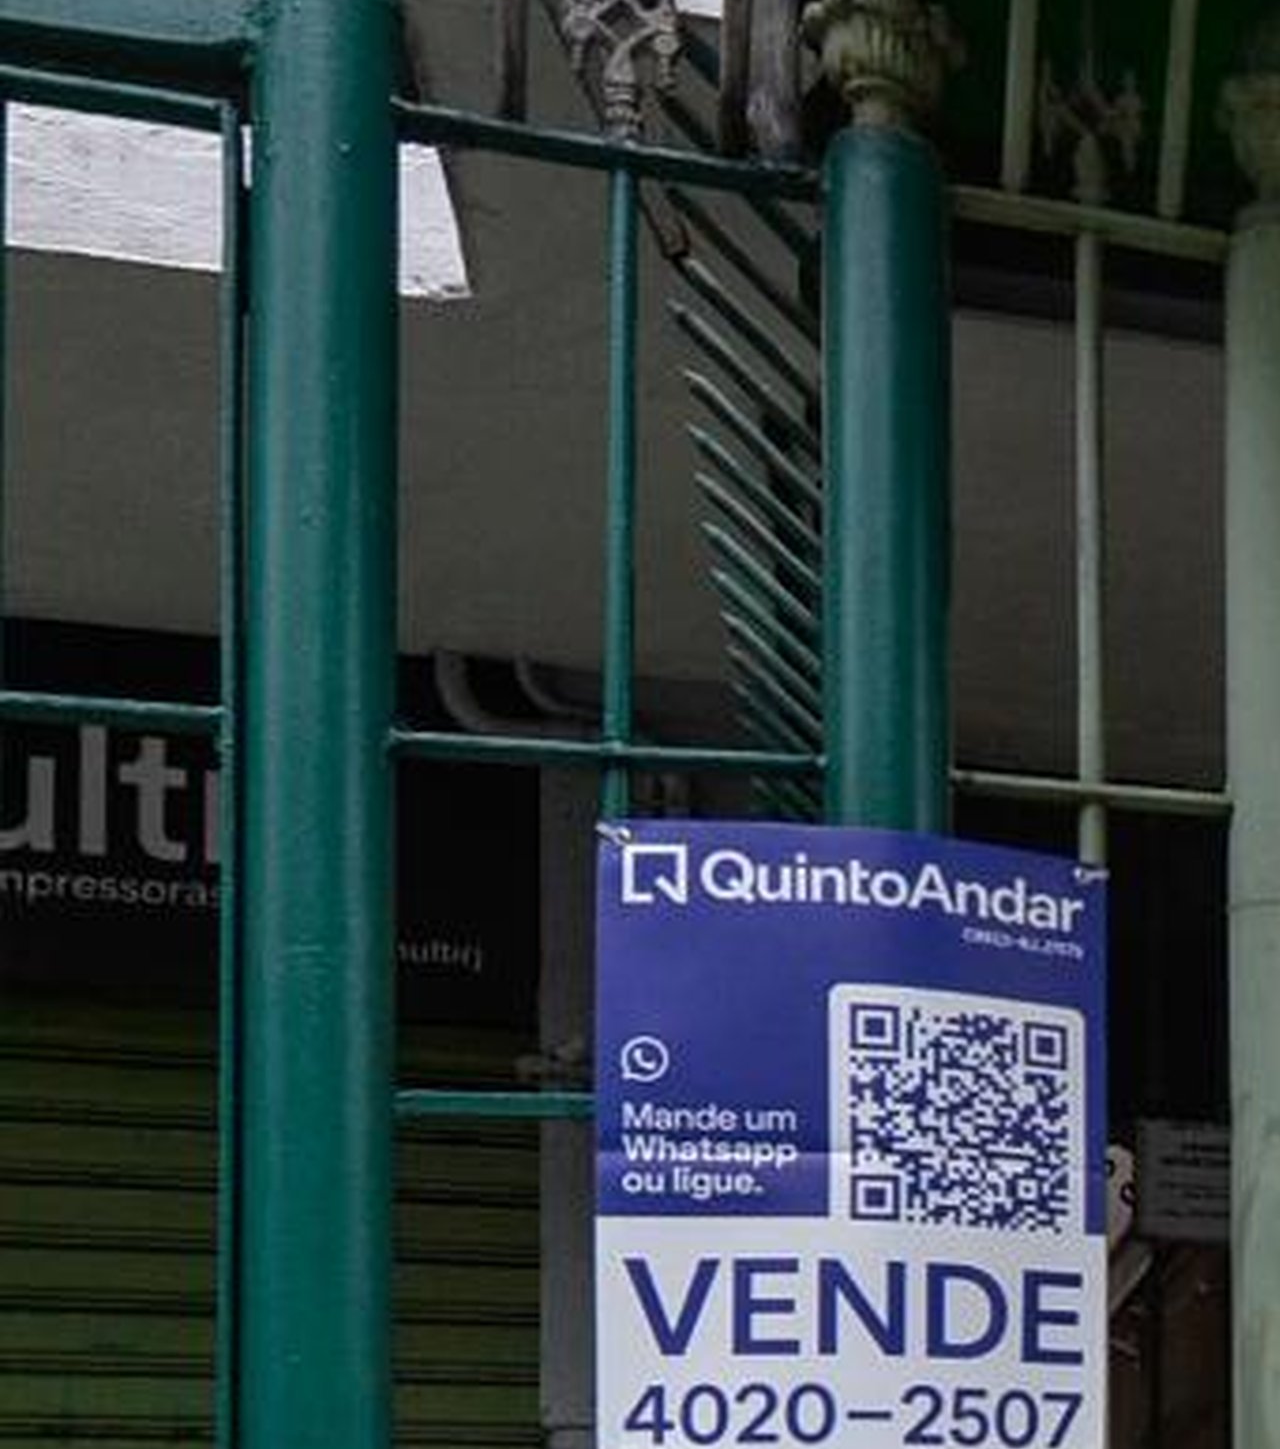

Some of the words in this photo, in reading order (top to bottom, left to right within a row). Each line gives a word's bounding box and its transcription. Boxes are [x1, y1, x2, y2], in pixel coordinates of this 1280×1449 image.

[699, 850, 1083, 932] QuintoAndar
[622, 1103, 735, 1132] Mande
[744, 1109, 797, 1133] um
[622, 1135, 798, 1170] Whatsapp
[621, 1173, 666, 1196] ou
[672, 1165, 764, 1201] ligue.
[624, 1256, 1084, 1366] VENDE
